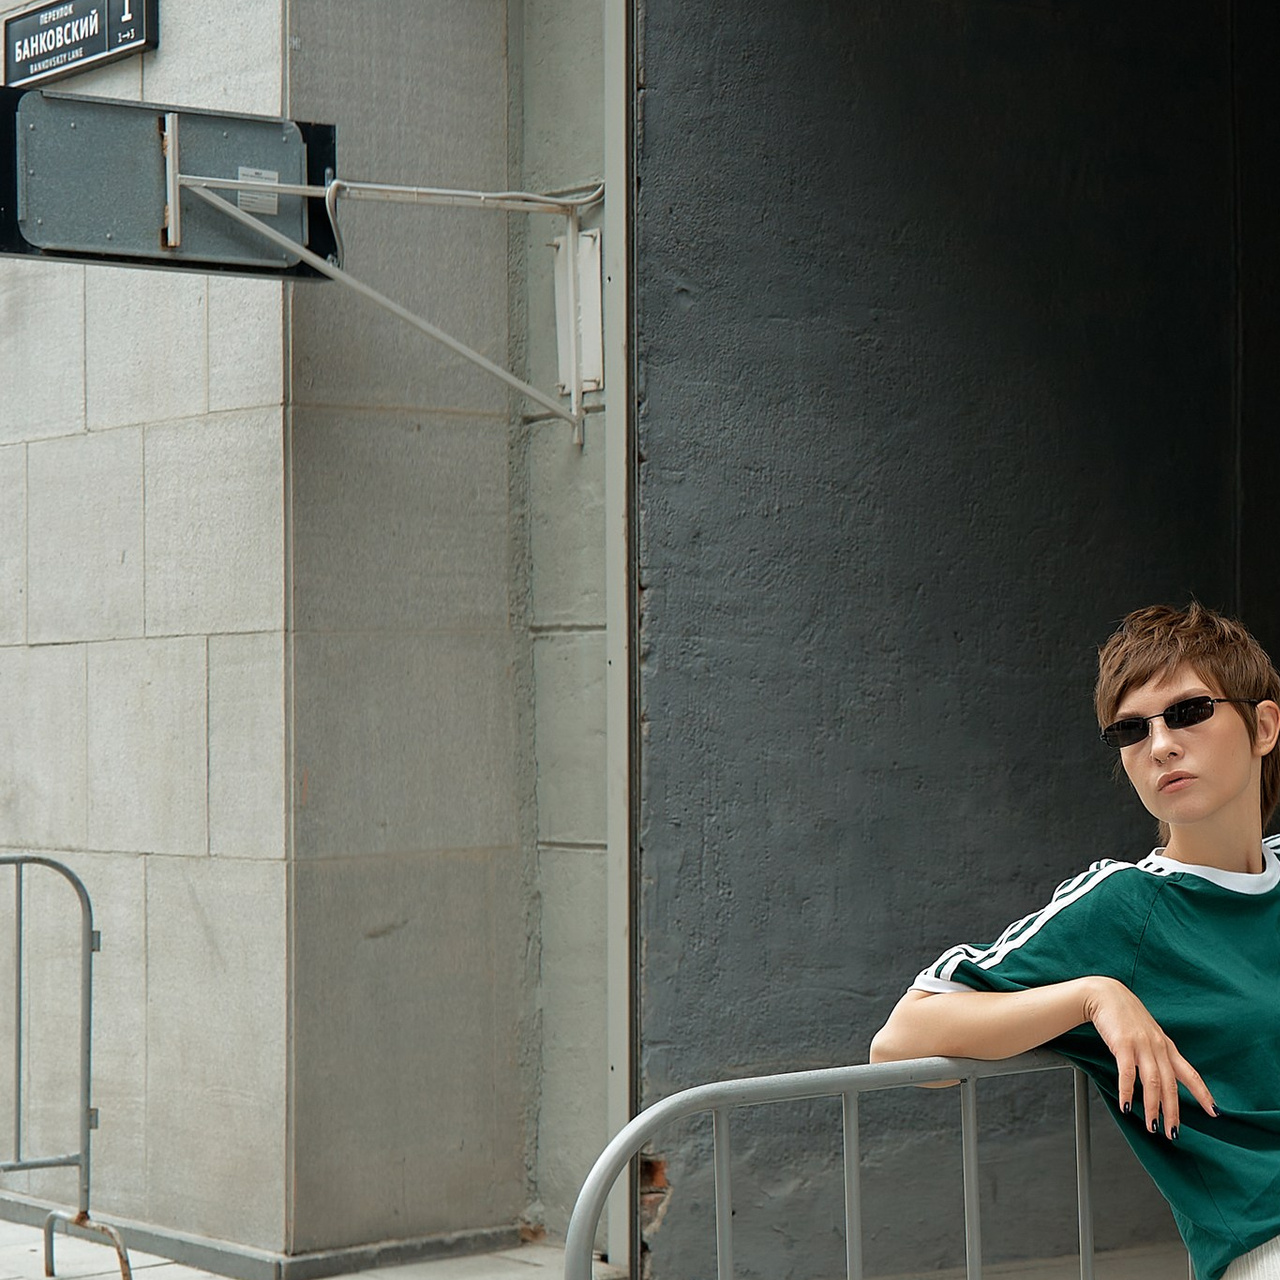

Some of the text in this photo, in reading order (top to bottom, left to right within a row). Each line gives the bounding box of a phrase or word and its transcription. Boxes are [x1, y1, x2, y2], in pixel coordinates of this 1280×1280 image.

[39, 4, 74, 26] ПЕРЕУЛОК
[15, 9, 99, 63] БАНКОВСКИЙ
[67, 47, 84, 62] LANE
